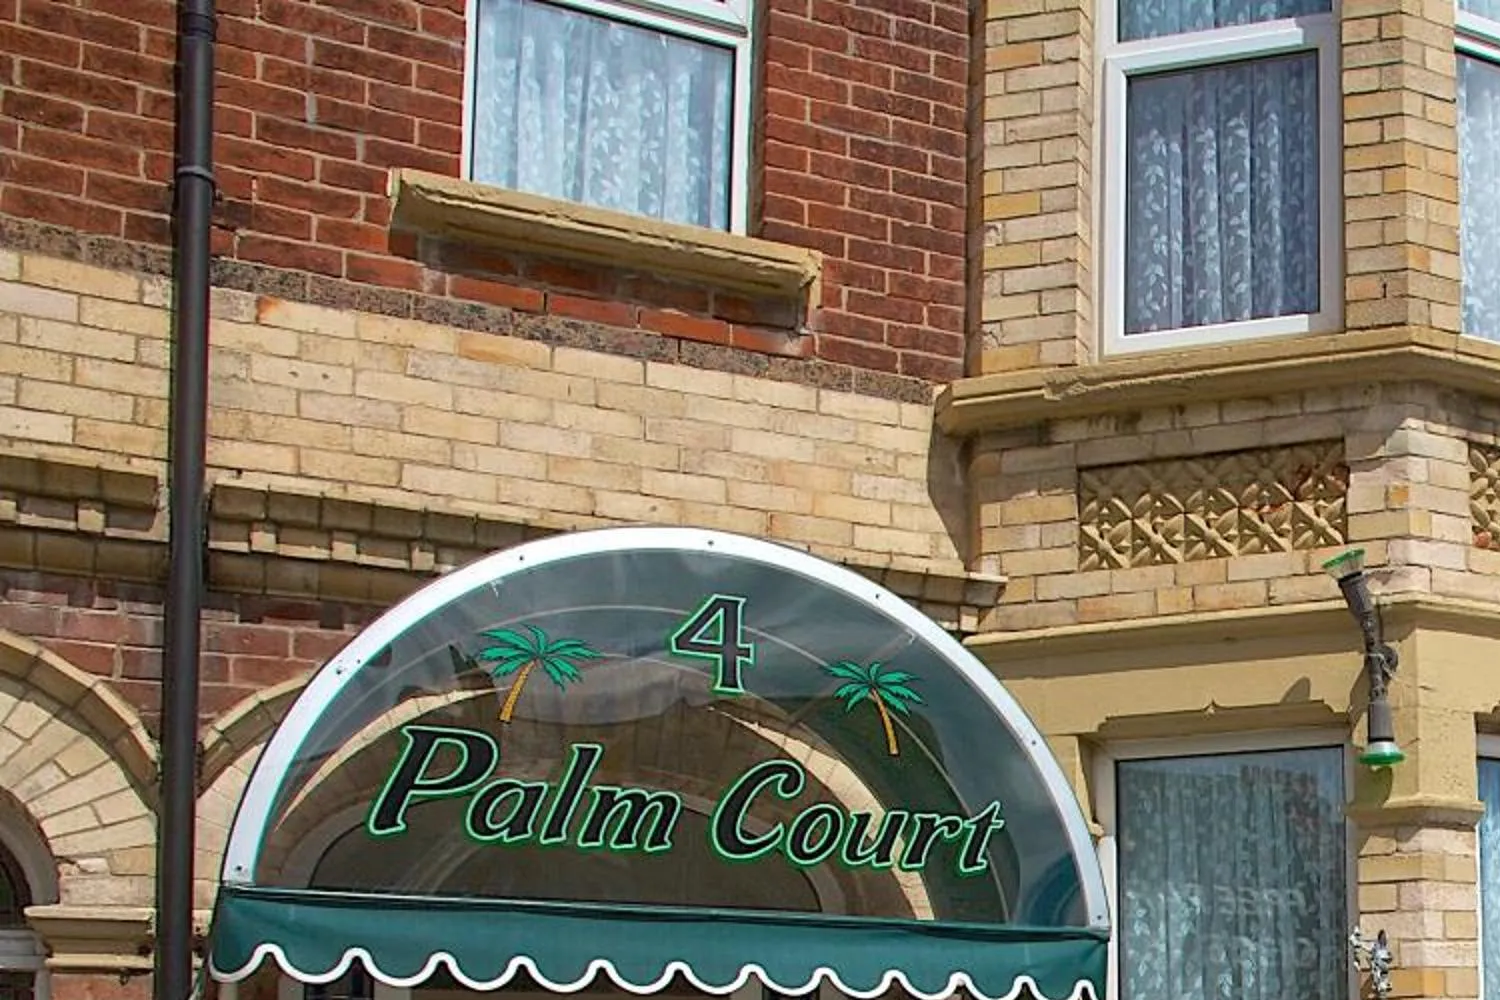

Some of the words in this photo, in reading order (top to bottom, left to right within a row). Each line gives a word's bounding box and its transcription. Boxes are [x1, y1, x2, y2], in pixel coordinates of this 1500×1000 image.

[671, 592, 756, 695] 4
[368, 724, 683, 854] Palm
[707, 758, 1006, 874] Court
